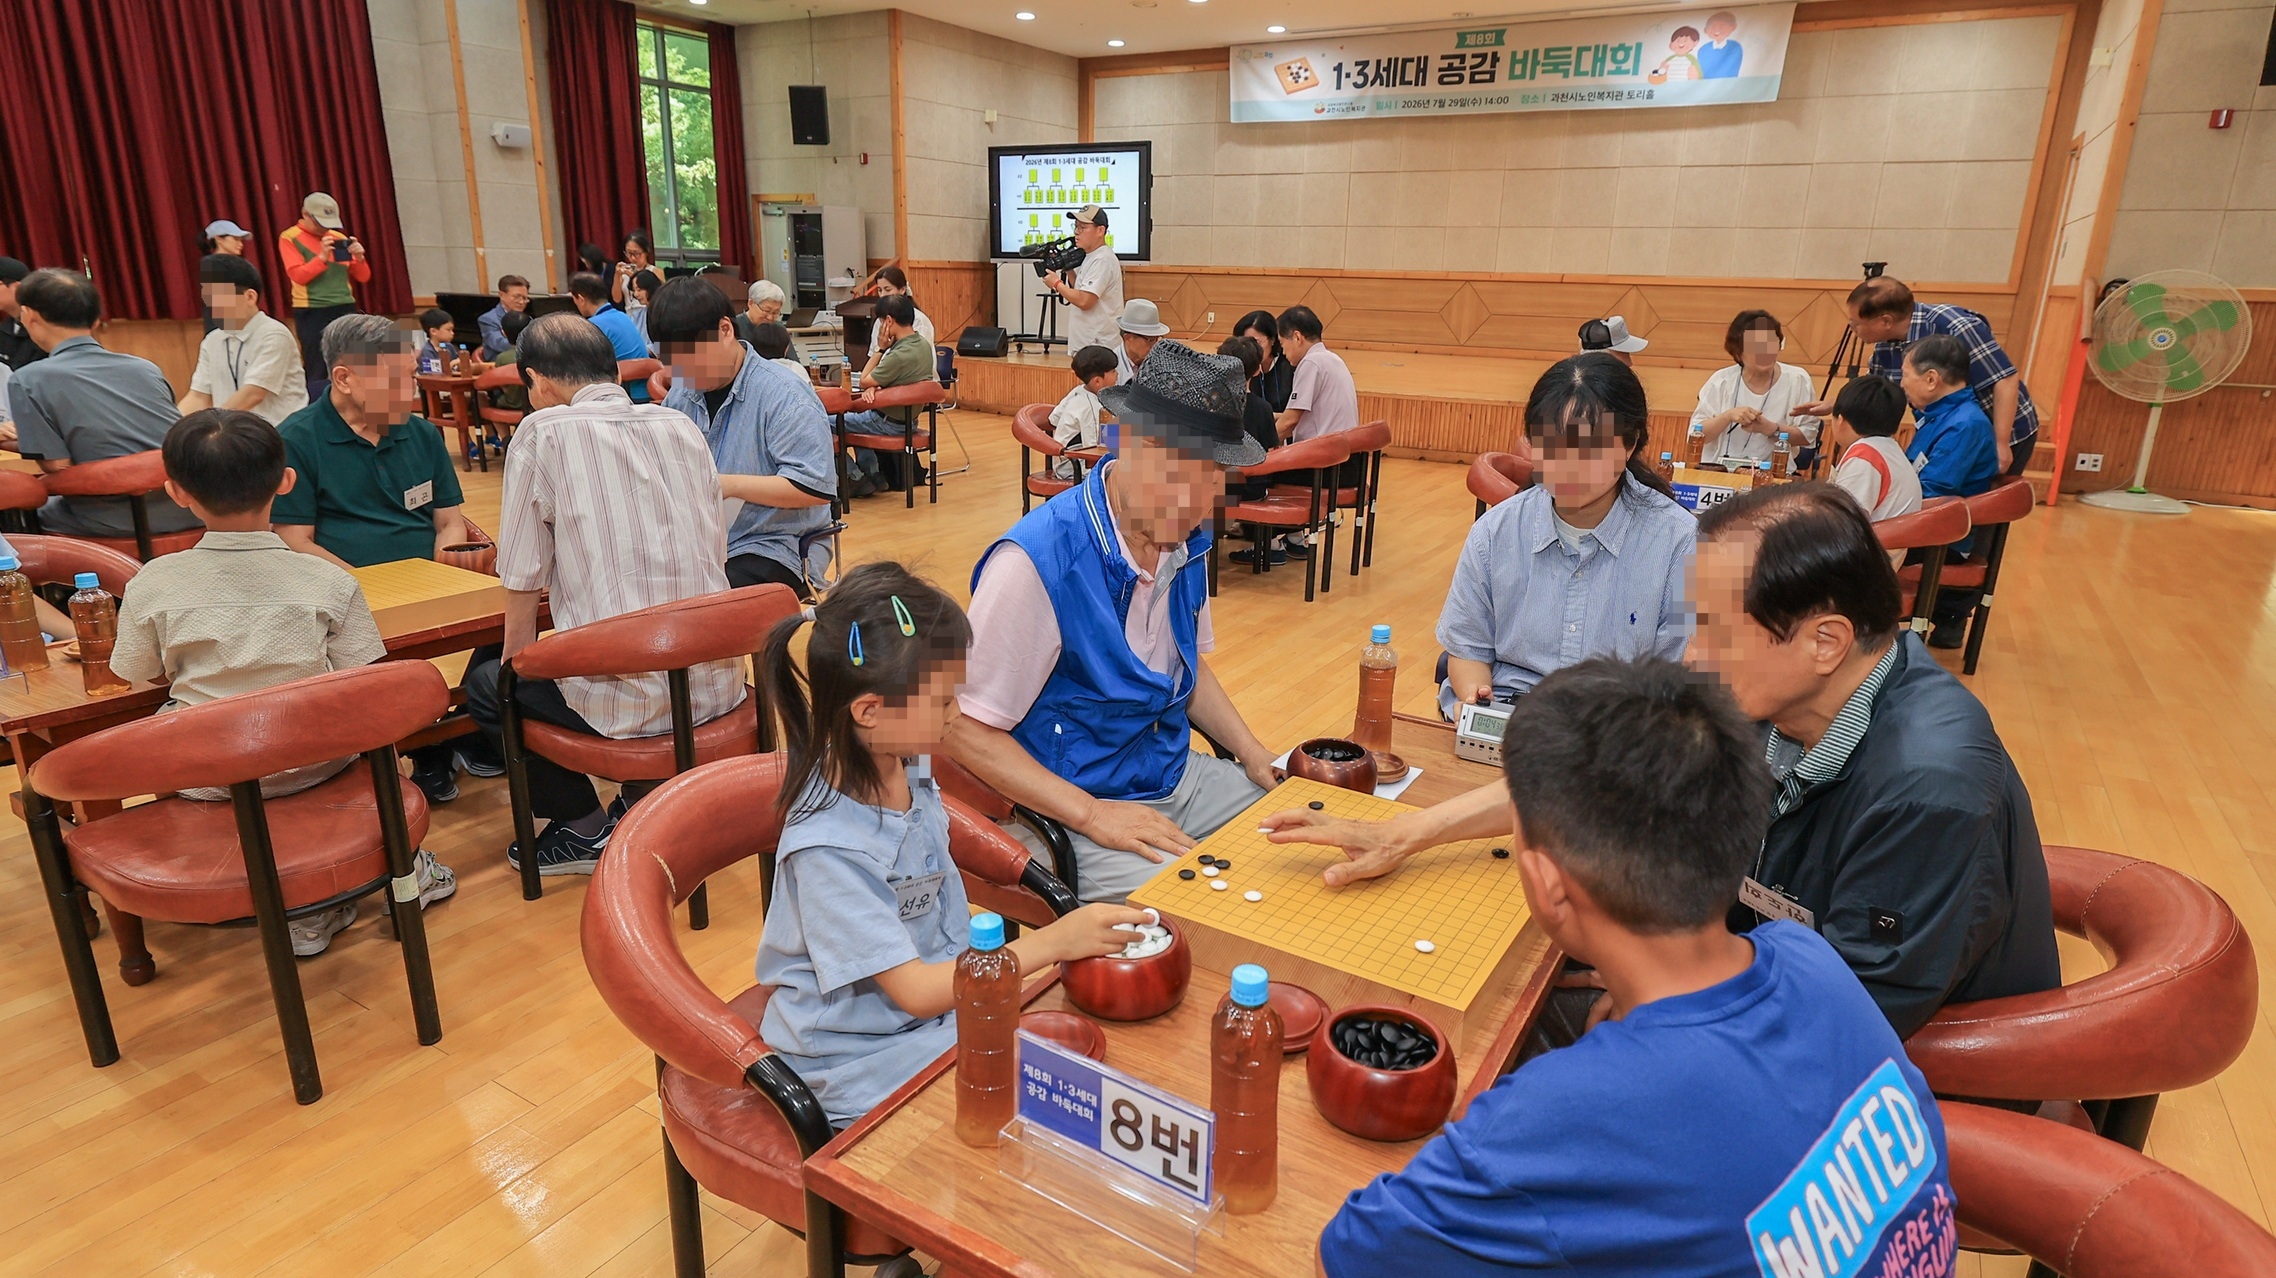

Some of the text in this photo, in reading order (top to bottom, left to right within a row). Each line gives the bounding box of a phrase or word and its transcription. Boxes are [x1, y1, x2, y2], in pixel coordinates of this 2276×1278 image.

[1465, 33, 1495, 46] 제8회
[1333, 41, 1644, 90] 1·3세대 공감 바둑대회
[1402, 99, 1431, 109] 2026년
[1433, 98, 1446, 108] 7월
[1448, 97, 1482, 107] 29일(수)
[1485, 95, 1509, 105] 14:00
[1551, 90, 1624, 103] 과천시노인복지관
[1626, 89, 1655, 100] 토리홀
[1023, 1063, 1098, 1108] 제8회 1·3세대
[1026, 1081, 1094, 1122] 공감 바둑대회
[1110, 1098, 1199, 1193] 8번
[1758, 1085, 1926, 1278] WANTED
